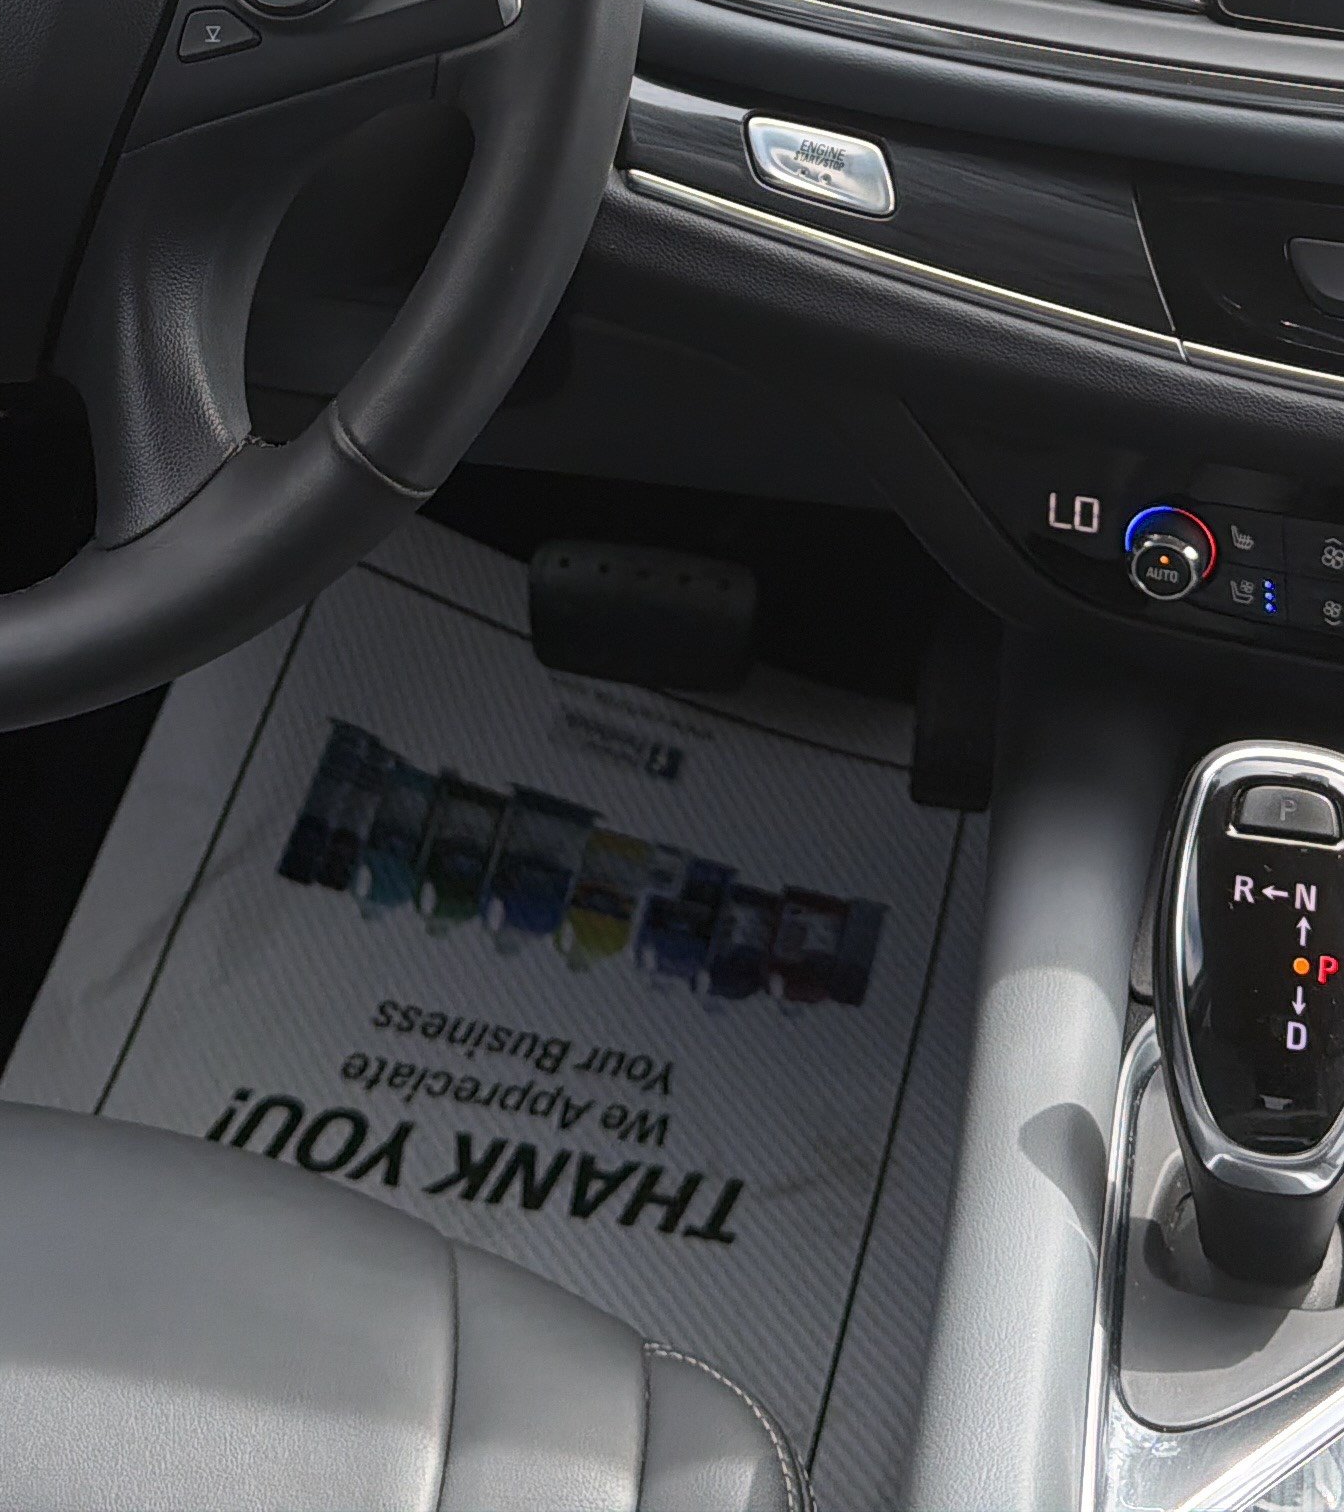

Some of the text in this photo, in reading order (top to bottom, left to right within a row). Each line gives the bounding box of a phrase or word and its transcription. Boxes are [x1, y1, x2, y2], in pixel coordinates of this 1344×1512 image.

[793, 150, 846, 171] START/STOP
[800, 139, 847, 162] ENGINE
[1145, 566, 1179, 584] AUTO
[1279, 798, 1298, 822] P
[1233, 874, 1317, 913] R N
[1316, 954, 1339, 985] P
[372, 998, 674, 1096] Your Business
[1285, 1022, 1308, 1051] D
[341, 1051, 670, 1147] We Appreciate
[205, 1086, 744, 1245] THANK YOU!
